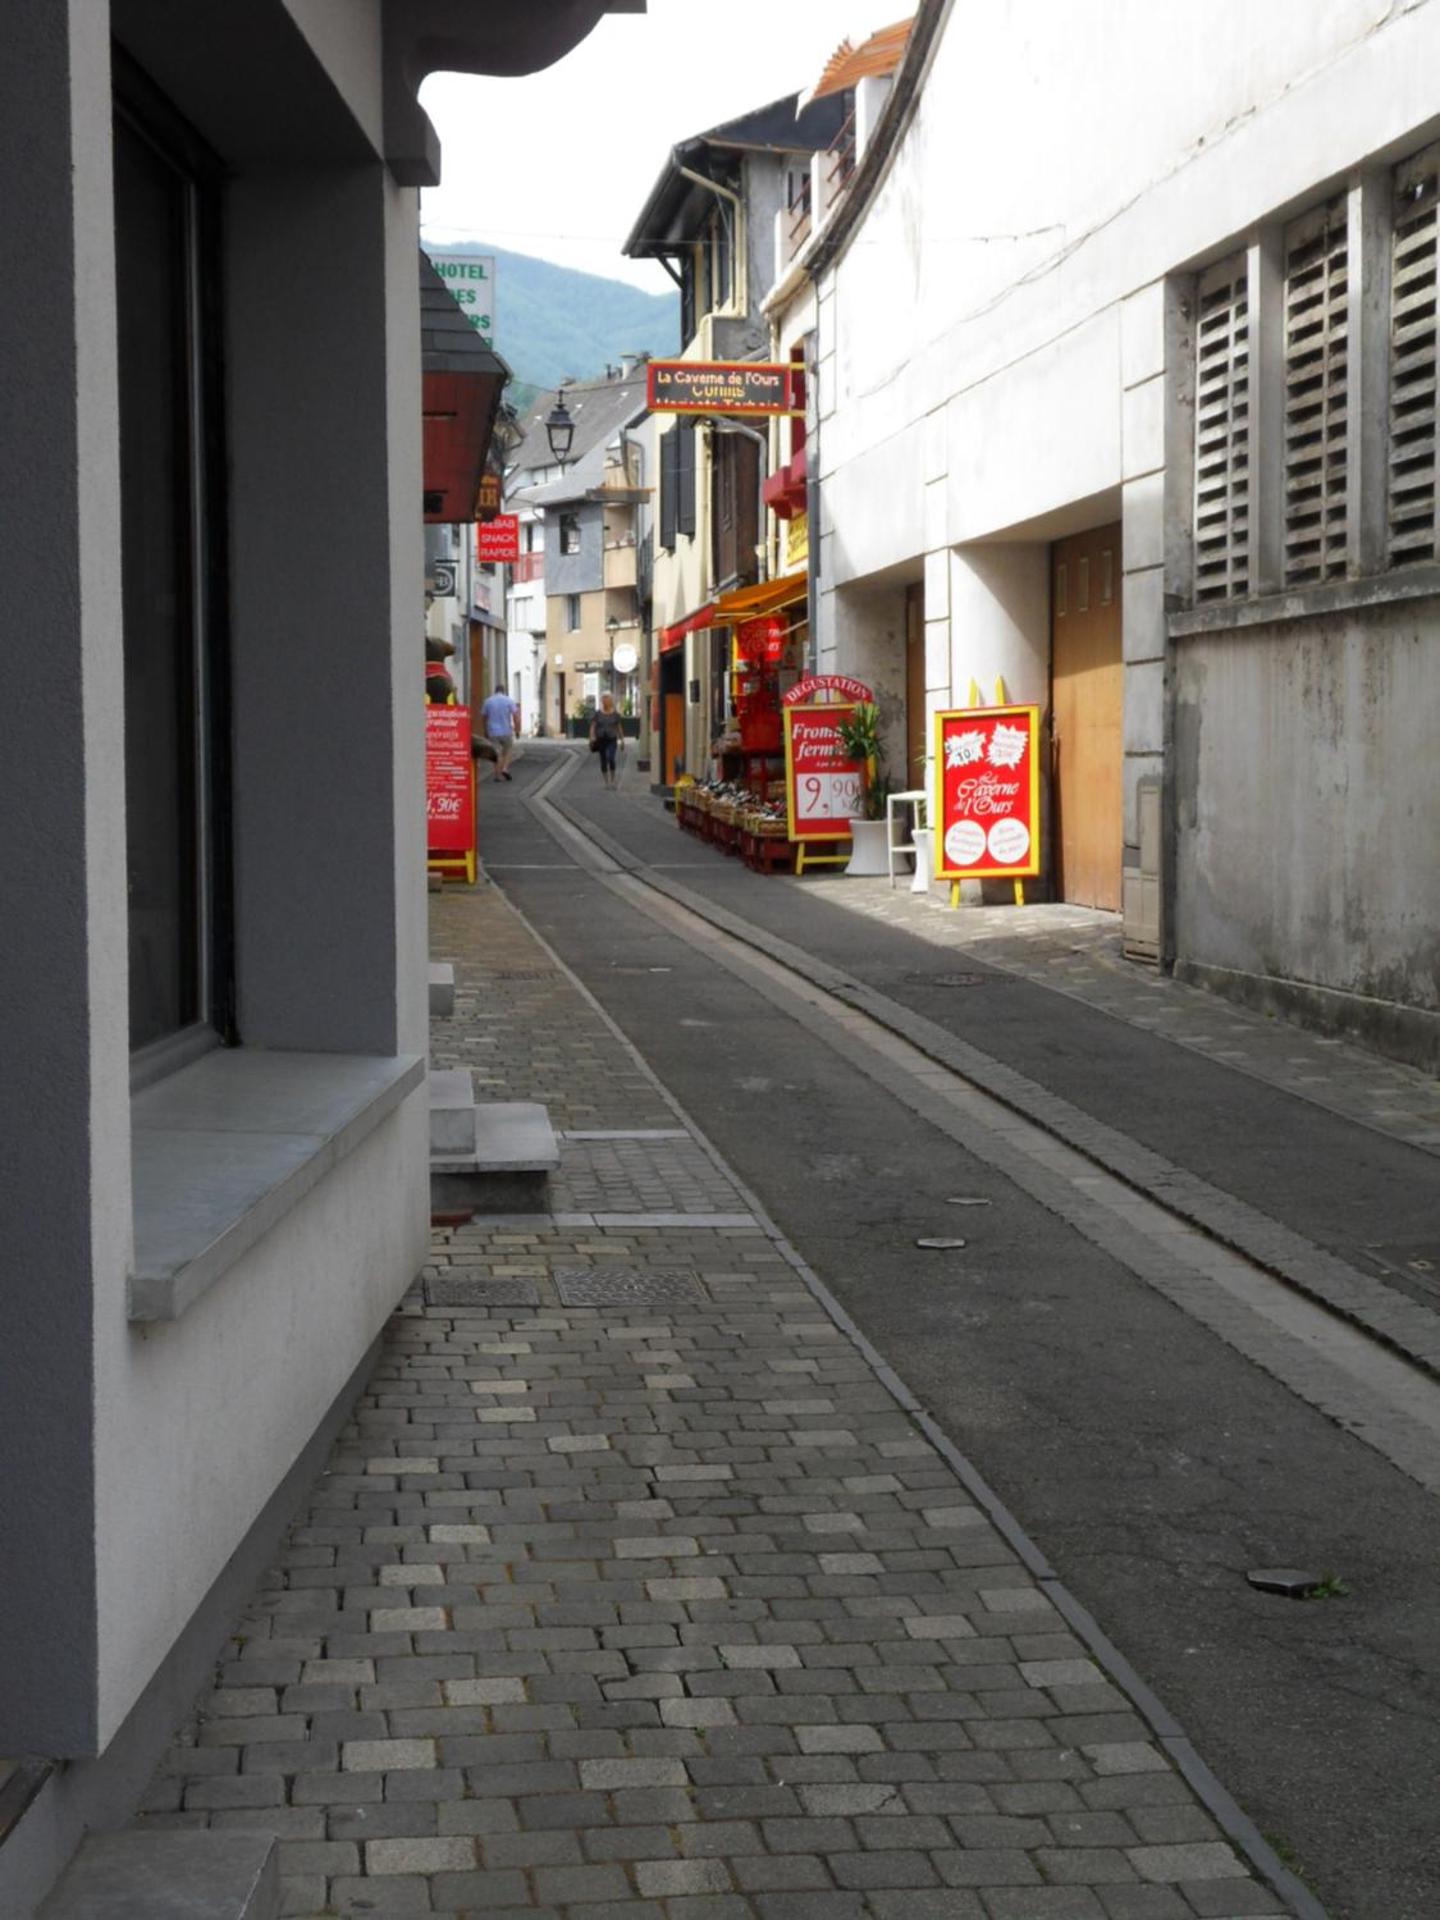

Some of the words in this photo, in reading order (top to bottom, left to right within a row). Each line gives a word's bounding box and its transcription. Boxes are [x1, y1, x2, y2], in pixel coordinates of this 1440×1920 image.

[434, 262, 488, 279] HOTEL
[657, 371, 671, 384] La
[674, 371, 725, 384] Caverne
[728, 371, 742, 385] de
[481, 533, 515, 544] SNACK
